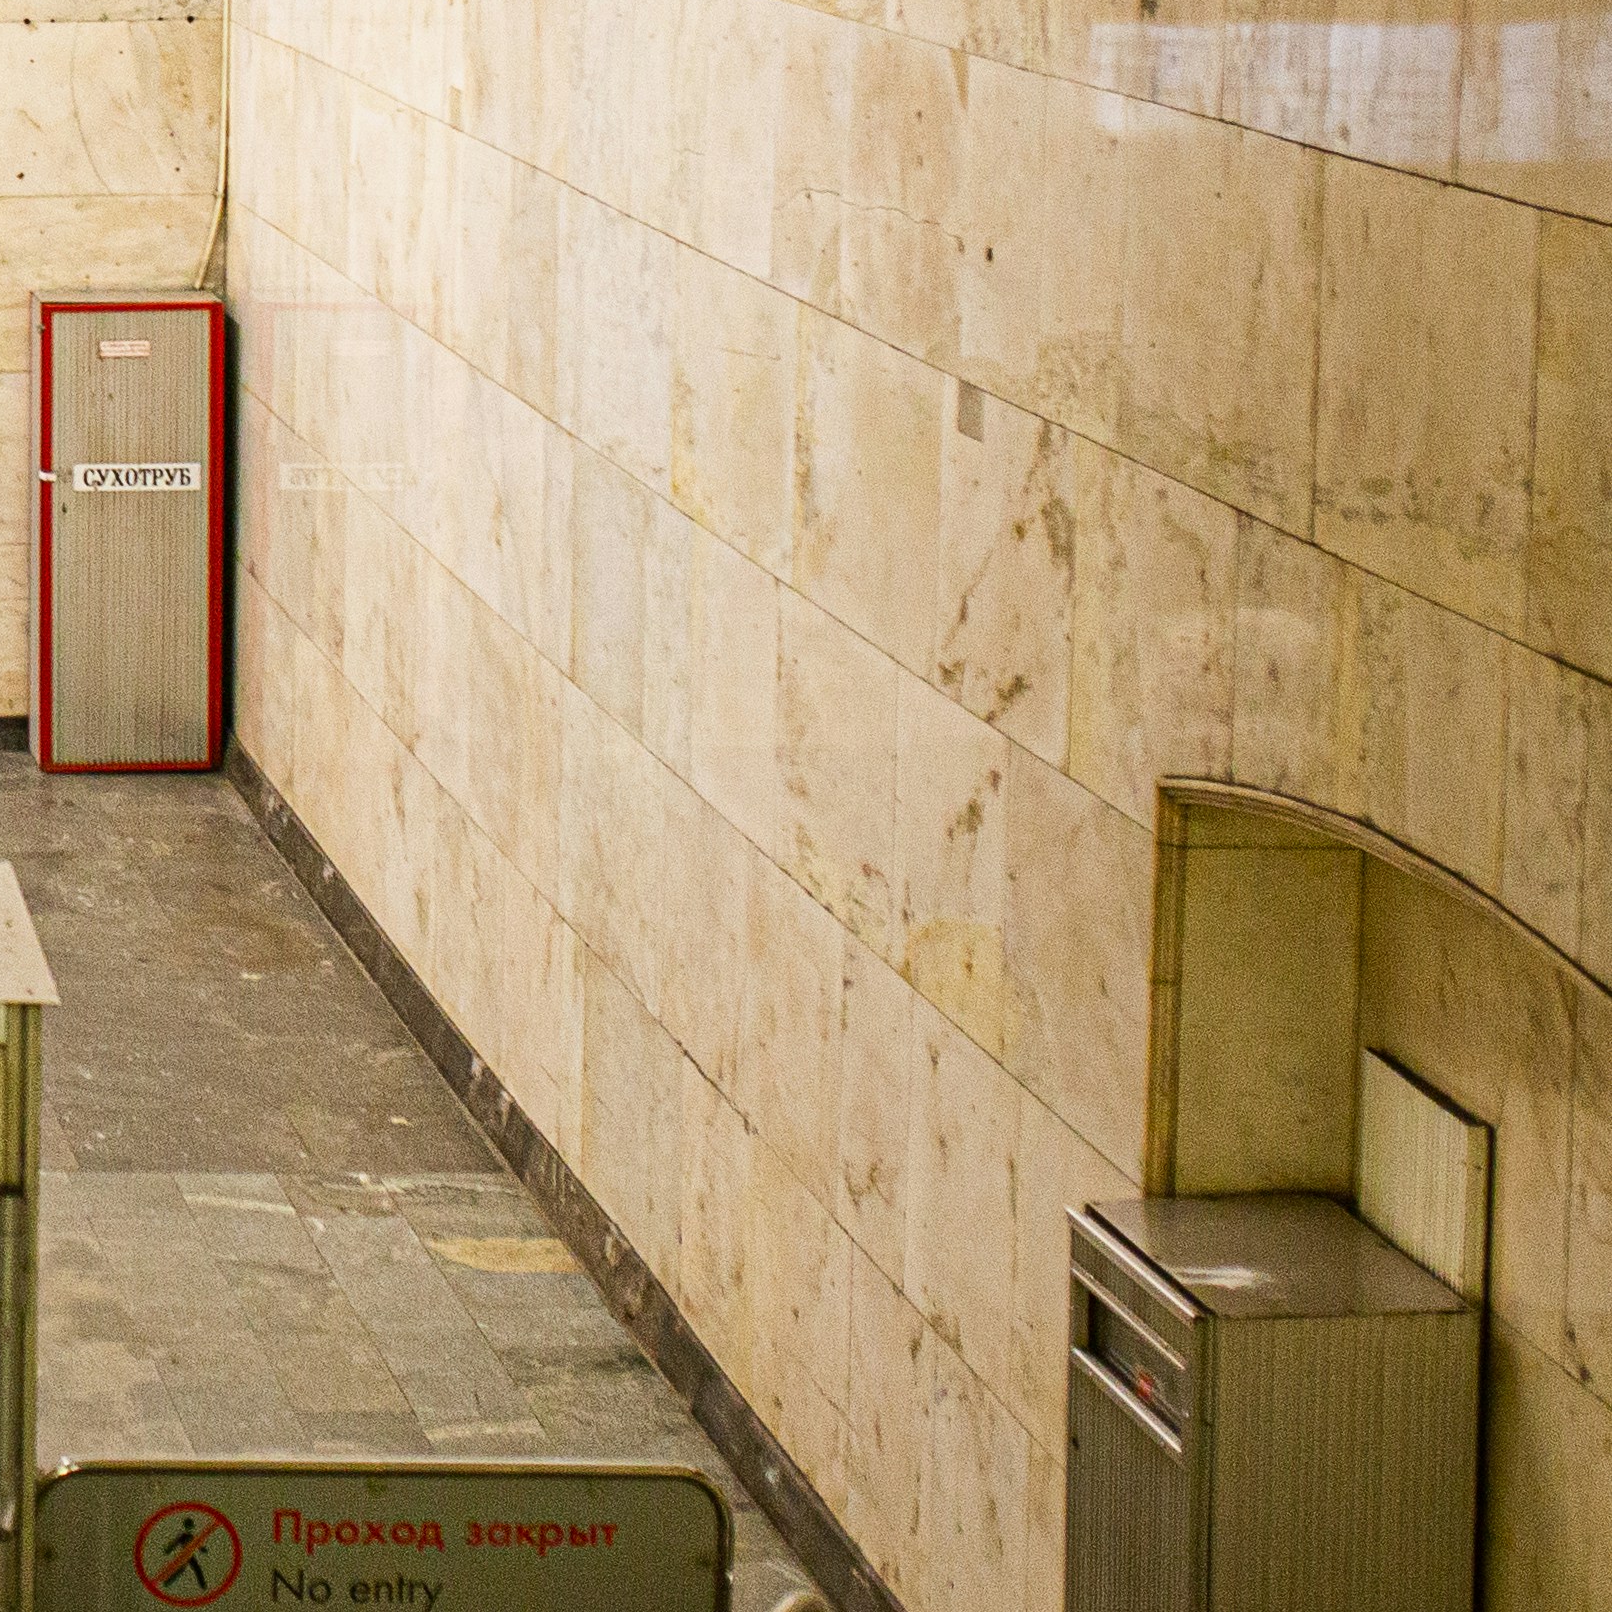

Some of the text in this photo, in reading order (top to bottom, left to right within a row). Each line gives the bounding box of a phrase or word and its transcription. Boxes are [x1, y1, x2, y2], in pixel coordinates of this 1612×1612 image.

[83, 468, 192, 487] СУХОТРУБ
[272, 1508, 619, 1558] Проход закрыт
[270, 1568, 444, 1612] No entry
